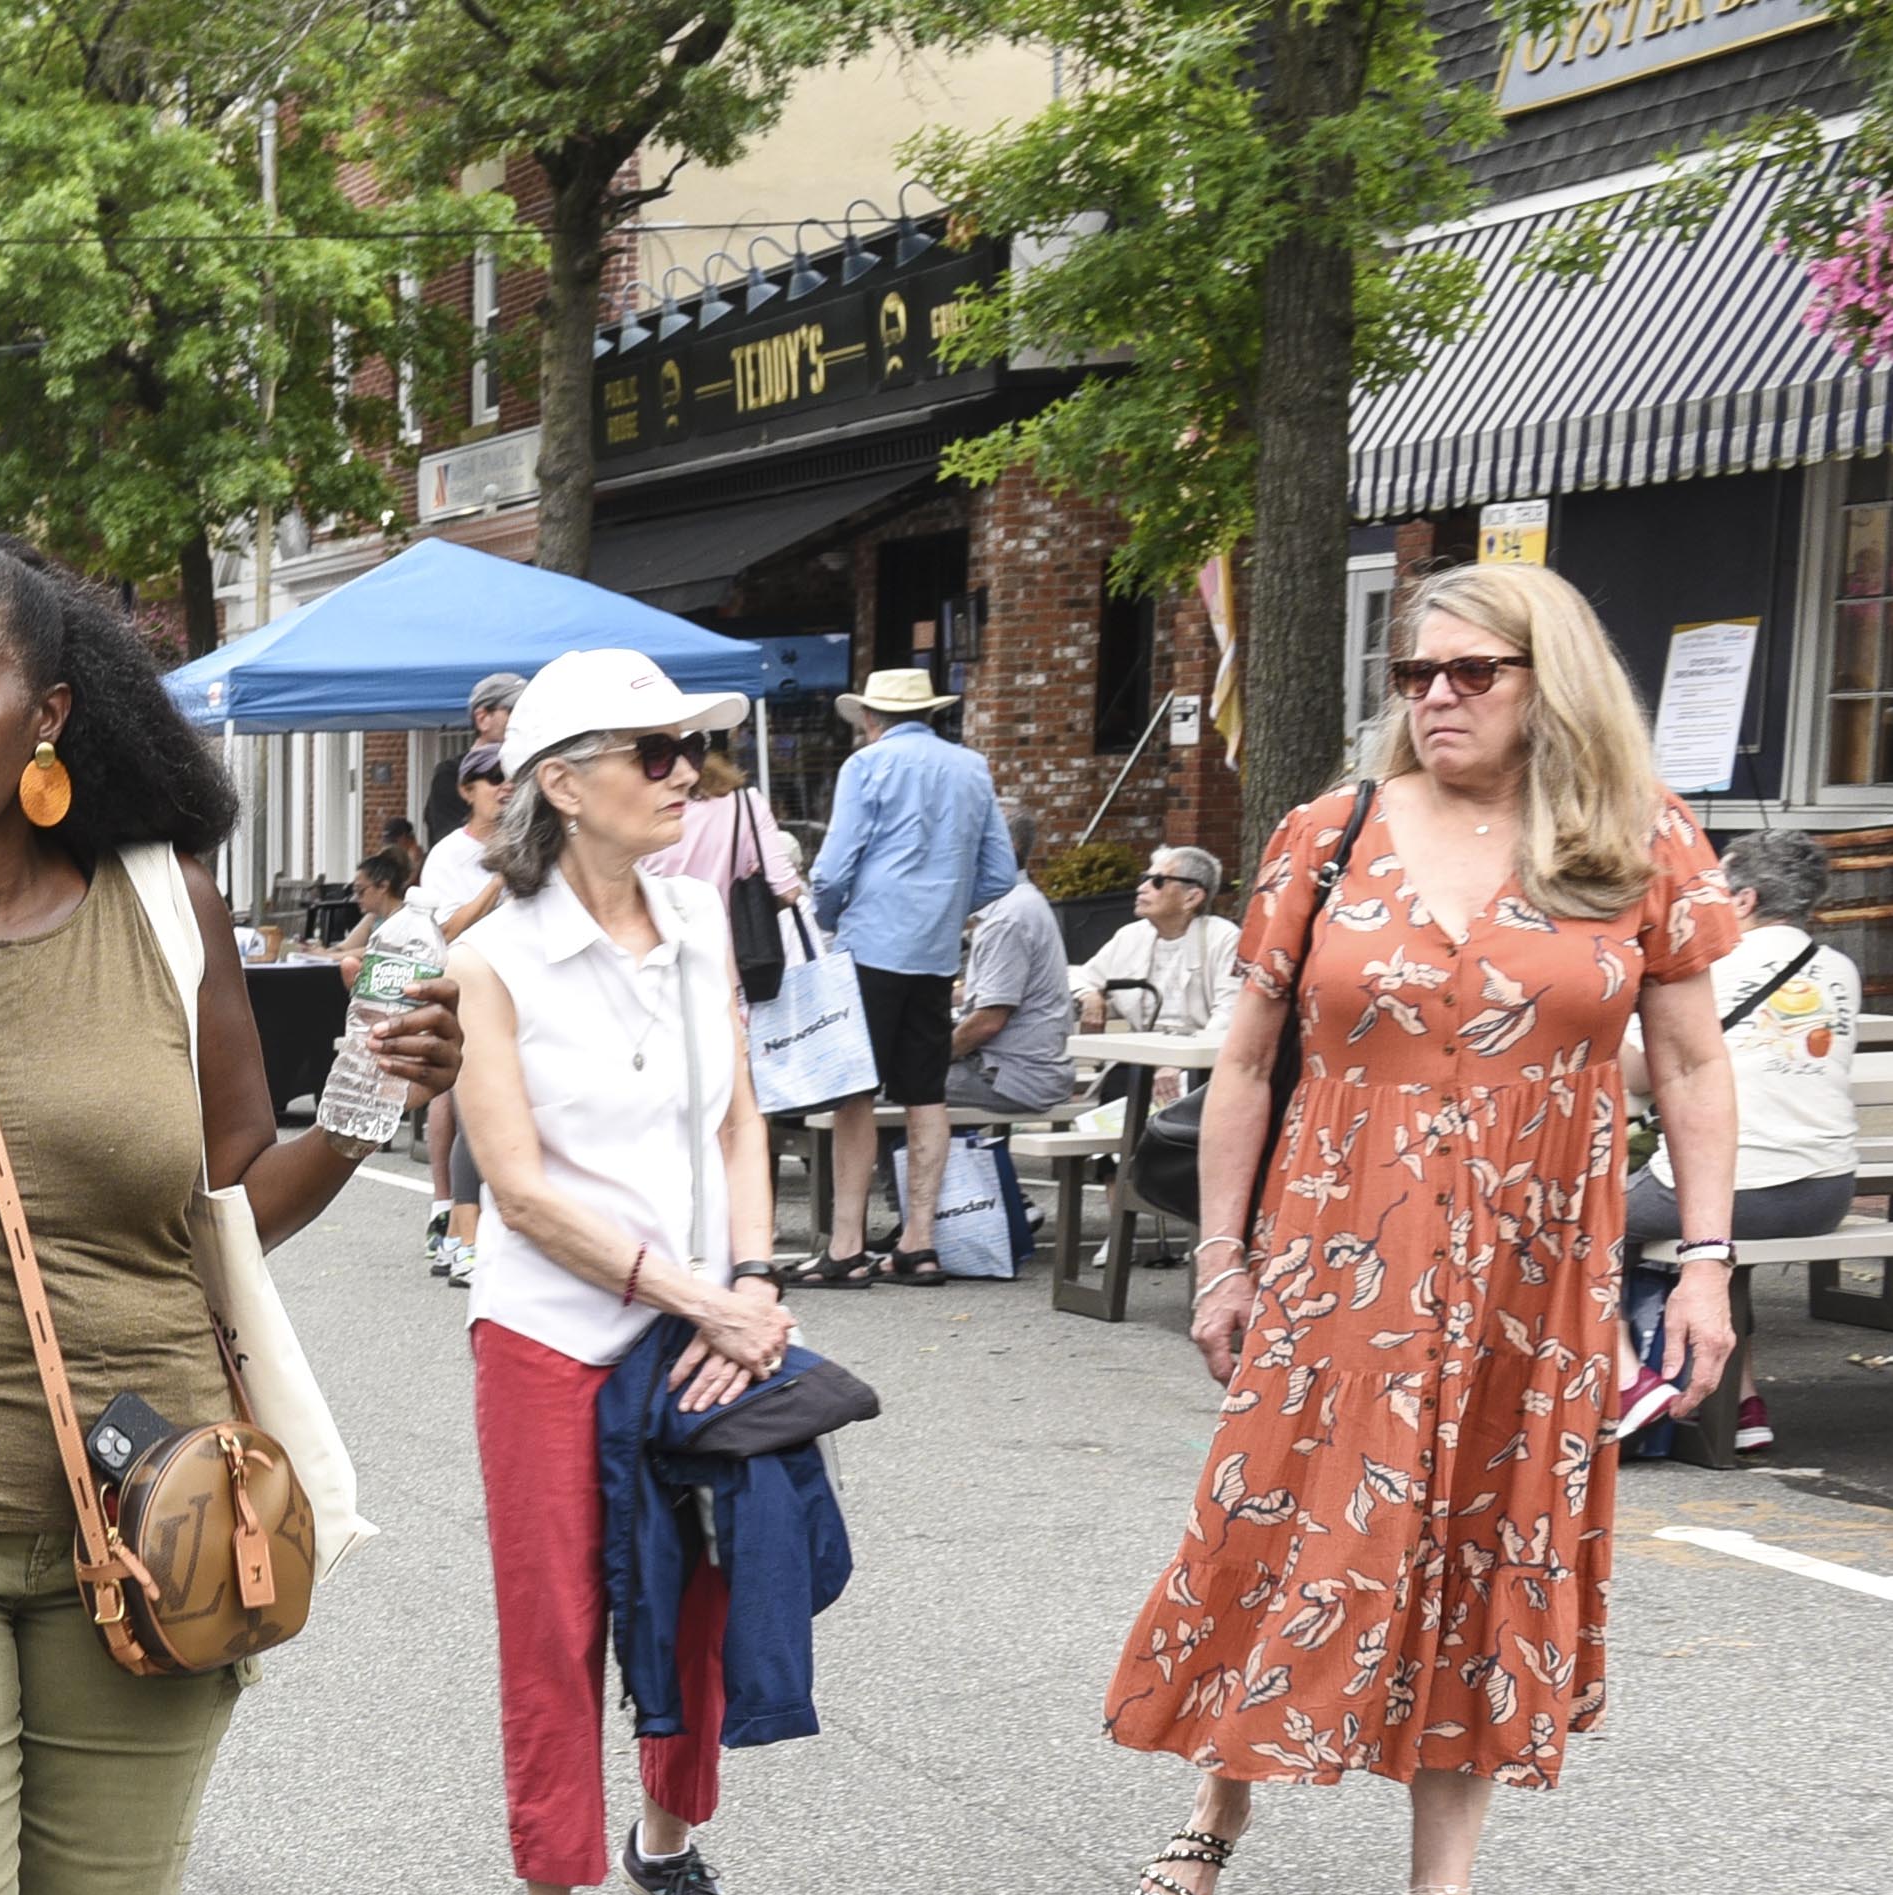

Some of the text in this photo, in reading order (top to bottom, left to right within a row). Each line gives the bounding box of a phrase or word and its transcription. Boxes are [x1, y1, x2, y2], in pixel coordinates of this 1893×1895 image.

[731, 323, 825, 412] TEDDY'S
[763, 1008, 850, 1054] Newsday
[934, 1197, 997, 1221] wsday
